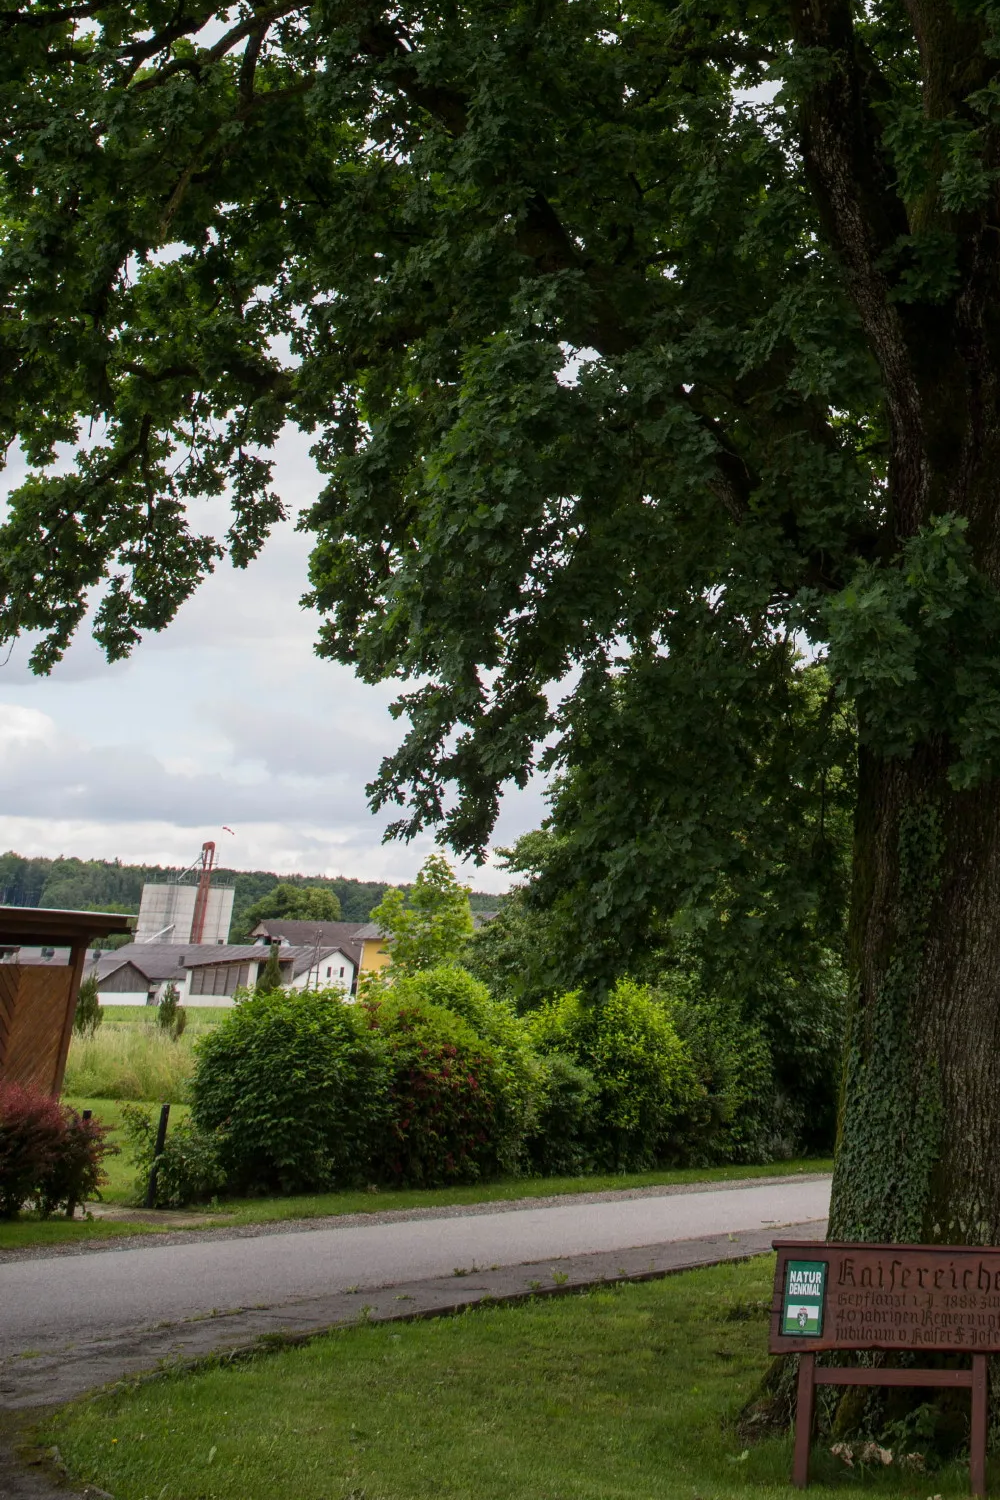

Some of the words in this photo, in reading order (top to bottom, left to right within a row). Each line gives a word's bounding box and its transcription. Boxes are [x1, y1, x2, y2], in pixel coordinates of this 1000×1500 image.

[790, 1270, 822, 1284] NATUR
[789, 1283, 820, 1296] DENKMAL
[838, 1291, 906, 1308] Gepflanzt
[944, 1294, 977, 1309] 1888
